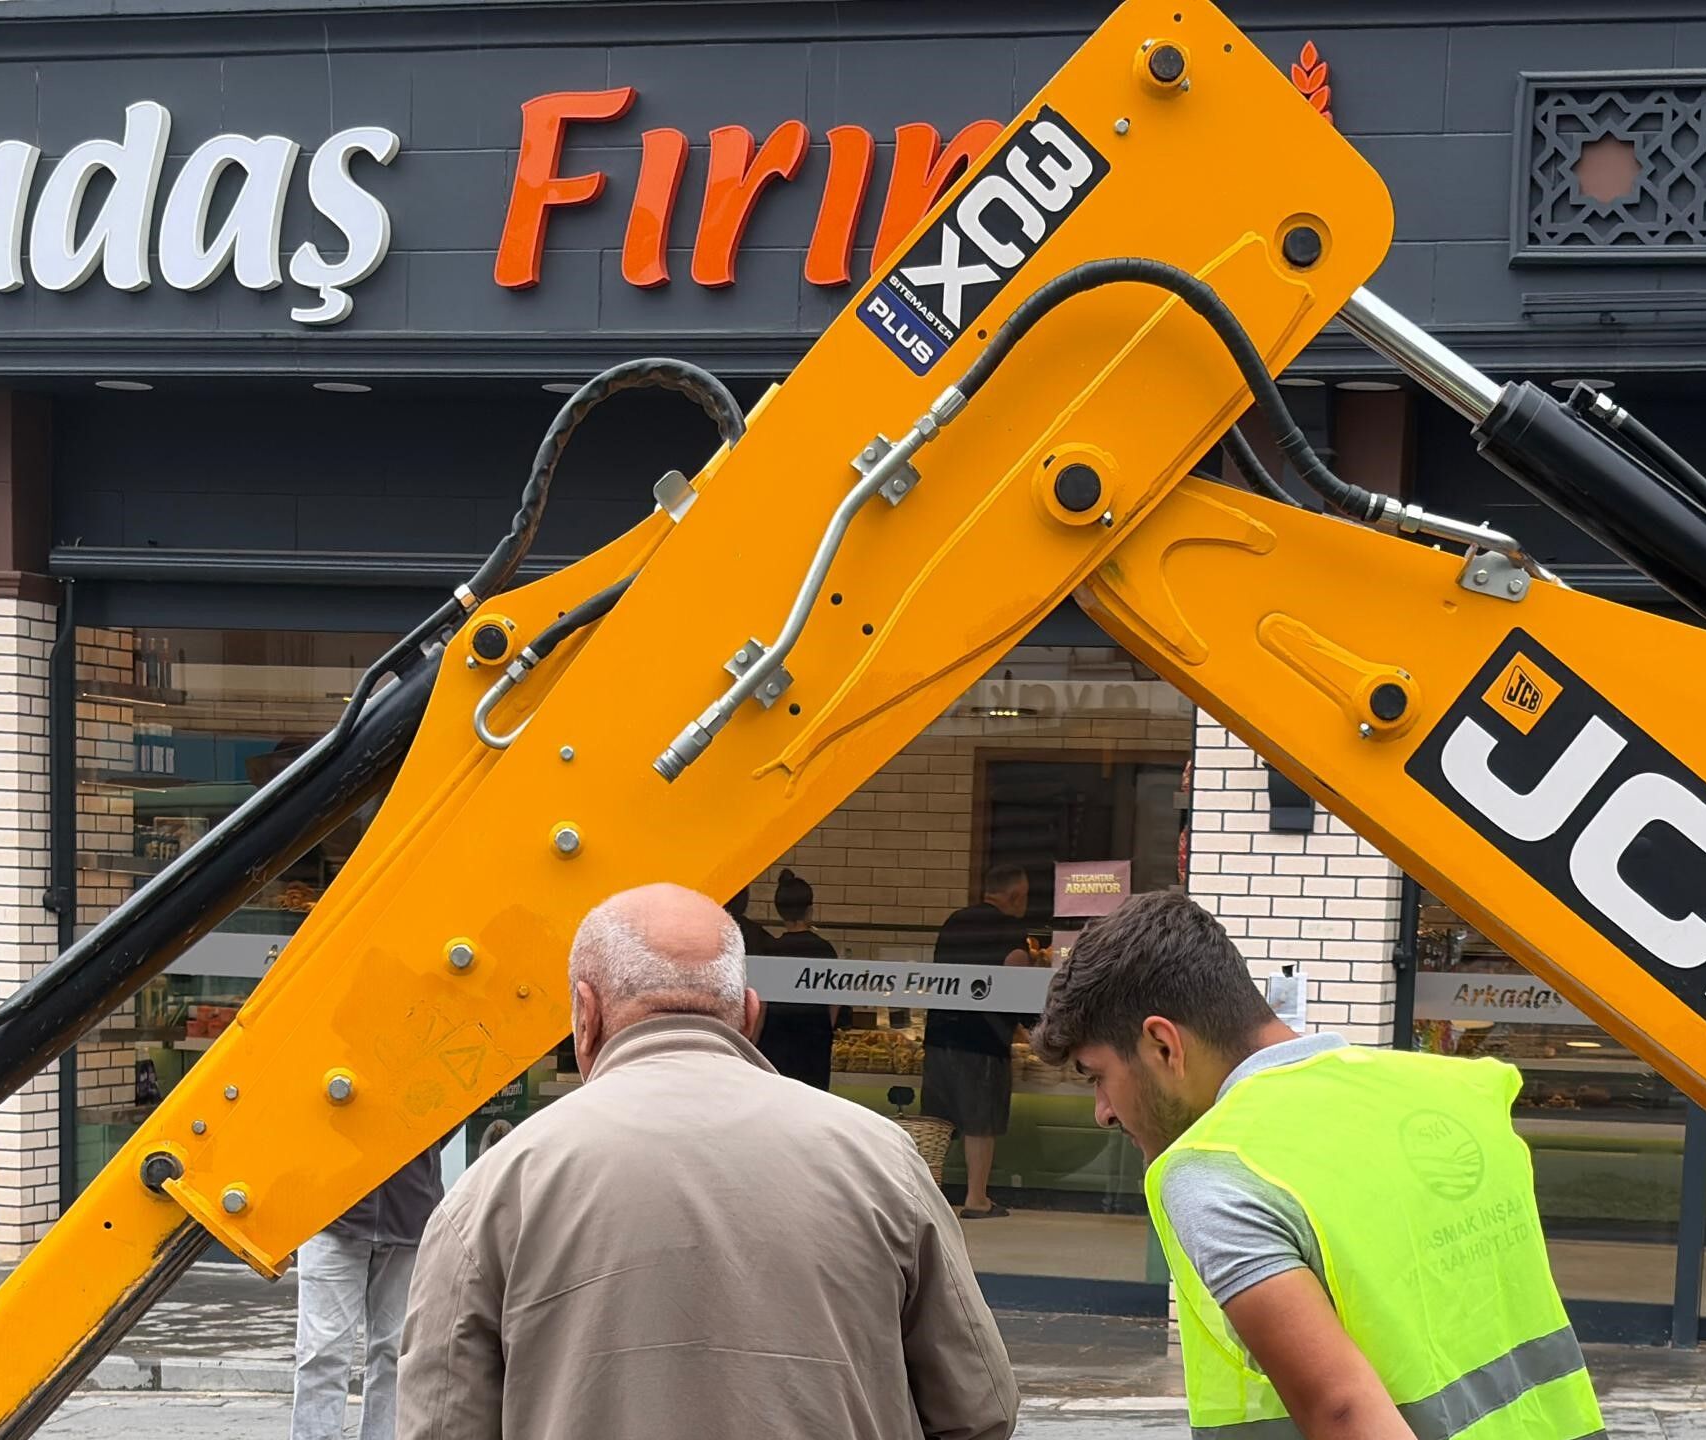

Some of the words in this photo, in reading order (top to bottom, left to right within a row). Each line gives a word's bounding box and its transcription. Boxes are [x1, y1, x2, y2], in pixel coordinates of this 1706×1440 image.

[888, 275, 954, 341] SITEMASTER
[866, 296, 934, 365] PLUS
[1506, 672, 1540, 711] JCB
[1064, 883, 1121, 894] ARANIYOR
[795, 966, 897, 996] Arkadaş
[905, 971, 961, 996] Fırın
